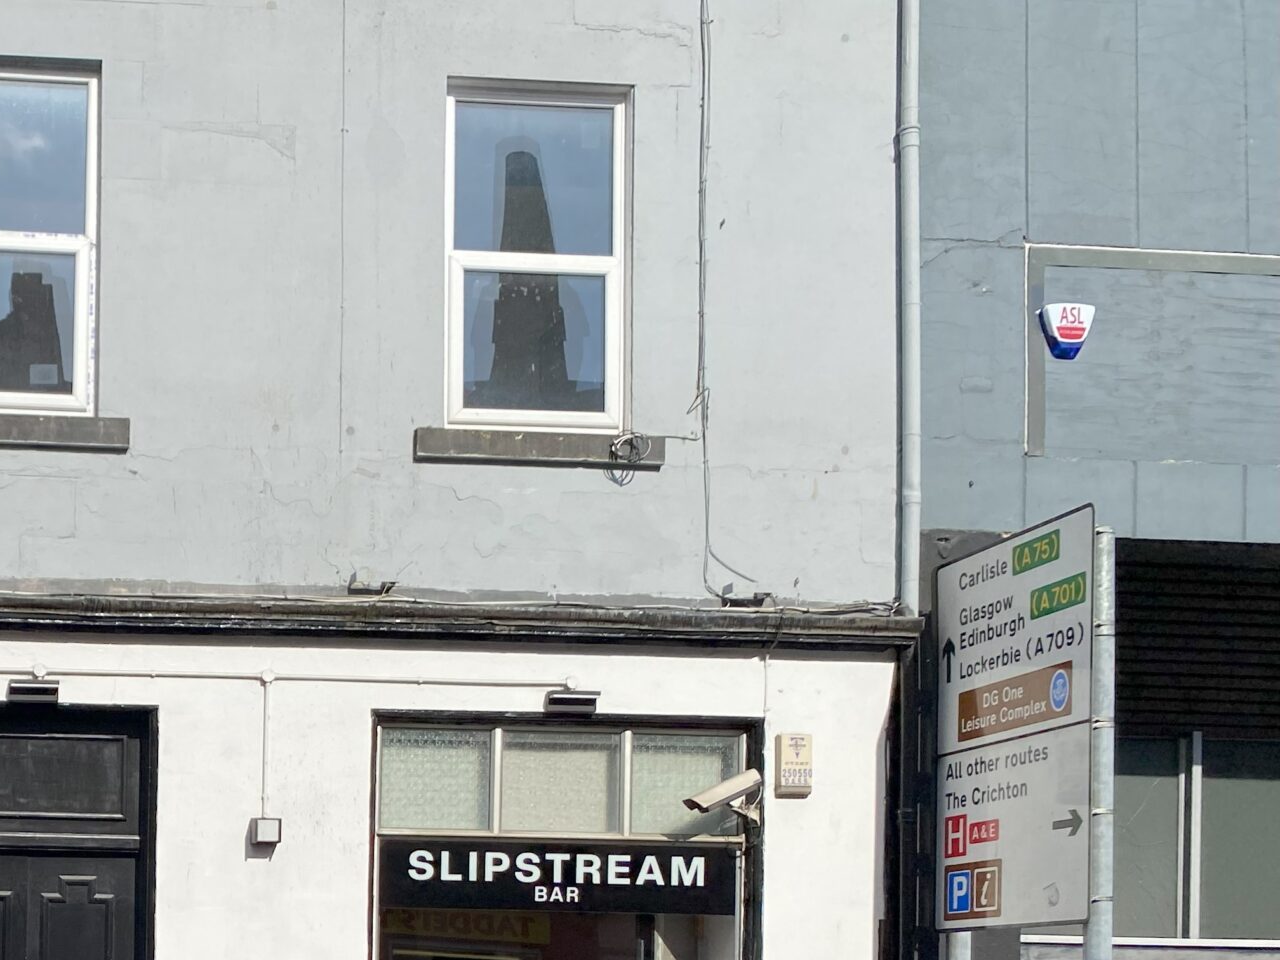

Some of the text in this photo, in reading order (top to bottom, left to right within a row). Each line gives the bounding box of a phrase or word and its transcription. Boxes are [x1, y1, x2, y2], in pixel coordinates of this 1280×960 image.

[1060, 306, 1084, 324] ASL
[959, 559, 1008, 591] Carlisle
[959, 595, 1014, 626] Glasgow
[959, 614, 1025, 650] Edinburgh
[959, 646, 1021, 680] Lockerbie
[983, 685, 1024, 707] DG One
[961, 701, 1046, 733] Leisure Complex
[946, 746, 1049, 781] All other routes
[946, 781, 1028, 810] The Crichton
[972, 824, 996, 839] A&E
[408, 849, 706, 887] SLIPSTREAM
[534, 886, 579, 903] BAR
[953, 875, 967, 909] P
